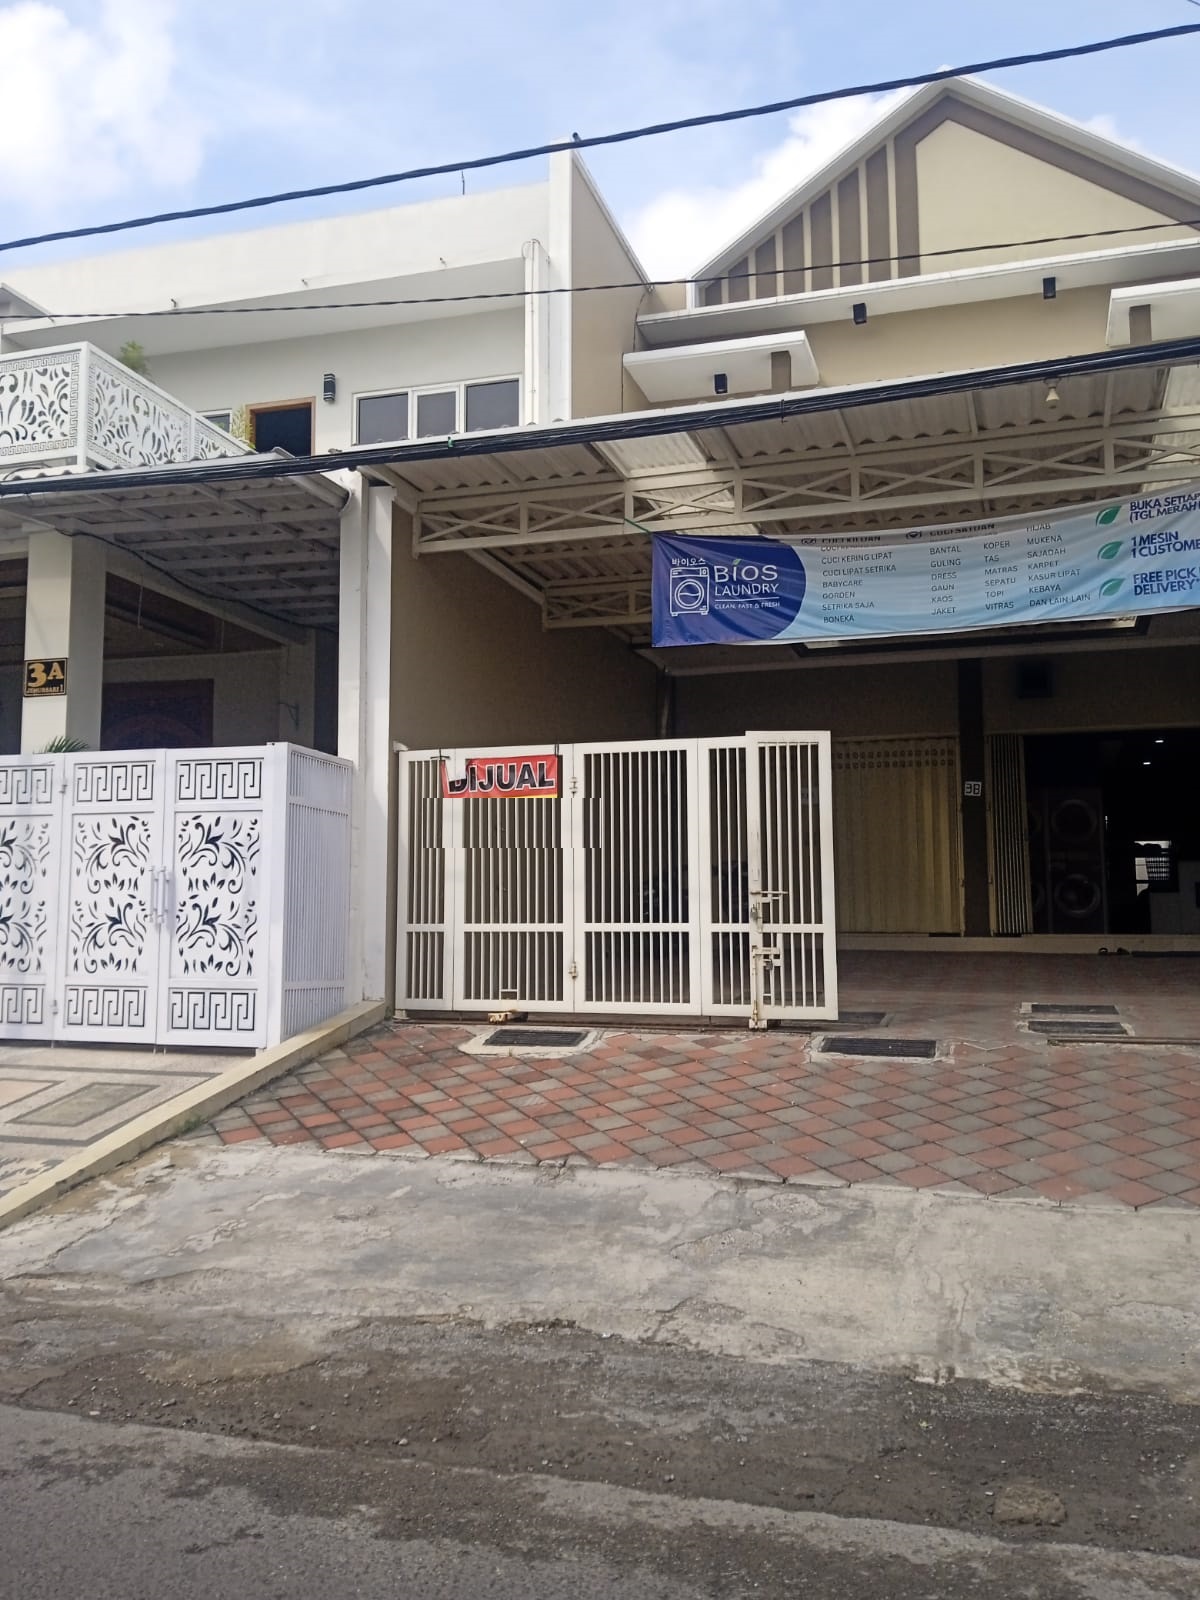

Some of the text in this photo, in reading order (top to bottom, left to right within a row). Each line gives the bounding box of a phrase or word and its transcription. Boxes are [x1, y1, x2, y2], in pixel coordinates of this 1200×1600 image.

[1130, 499, 1161, 512] BUKA
[1130, 501, 1197, 523] (TGL MERAH
[1027, 534, 1063, 545] MUKENA
[1131, 531, 1179, 547] 1 MESIN
[930, 545, 961, 555] BANTAL
[983, 540, 1010, 550] KOPER
[1131, 539, 1200, 558] 1 CUSTOME
[1027, 548, 1066, 558] SAJADAH
[671, 558, 706, 567] 바이오스
[822, 552, 893, 565] CUCI KERING LIPAT
[930, 558, 961, 568] GULING
[984, 554, 1000, 563] TAS
[984, 565, 1018, 575] MATRAS
[1028, 560, 1058, 570] KARPET
[823, 564, 897, 577] CUCI LIPAT SETRIKA
[1028, 568, 1081, 582] KASUR LIPAT
[1133, 567, 1197, 584] FREE PICK
[931, 572, 957, 581] DRESS
[985, 577, 1016, 586] SEPATU
[823, 580, 863, 588] BABYCARE
[931, 584, 955, 592] GAUN
[1029, 584, 1061, 594] KEBAYA
[714, 583, 780, 596] LAUNDRY
[986, 590, 1004, 598] TOPI
[823, 591, 855, 599] GORDEN
[931, 595, 953, 603] KAOS
[822, 601, 875, 611] SETRIKA SAJA
[985, 601, 1014, 611] VITRAS
[1029, 599, 1047, 607] DAN
[931, 607, 957, 616] JAKET
[823, 615, 855, 623] BONEKA
[28, 662, 64, 687] 3A
[964, 783, 981, 795] 3B
